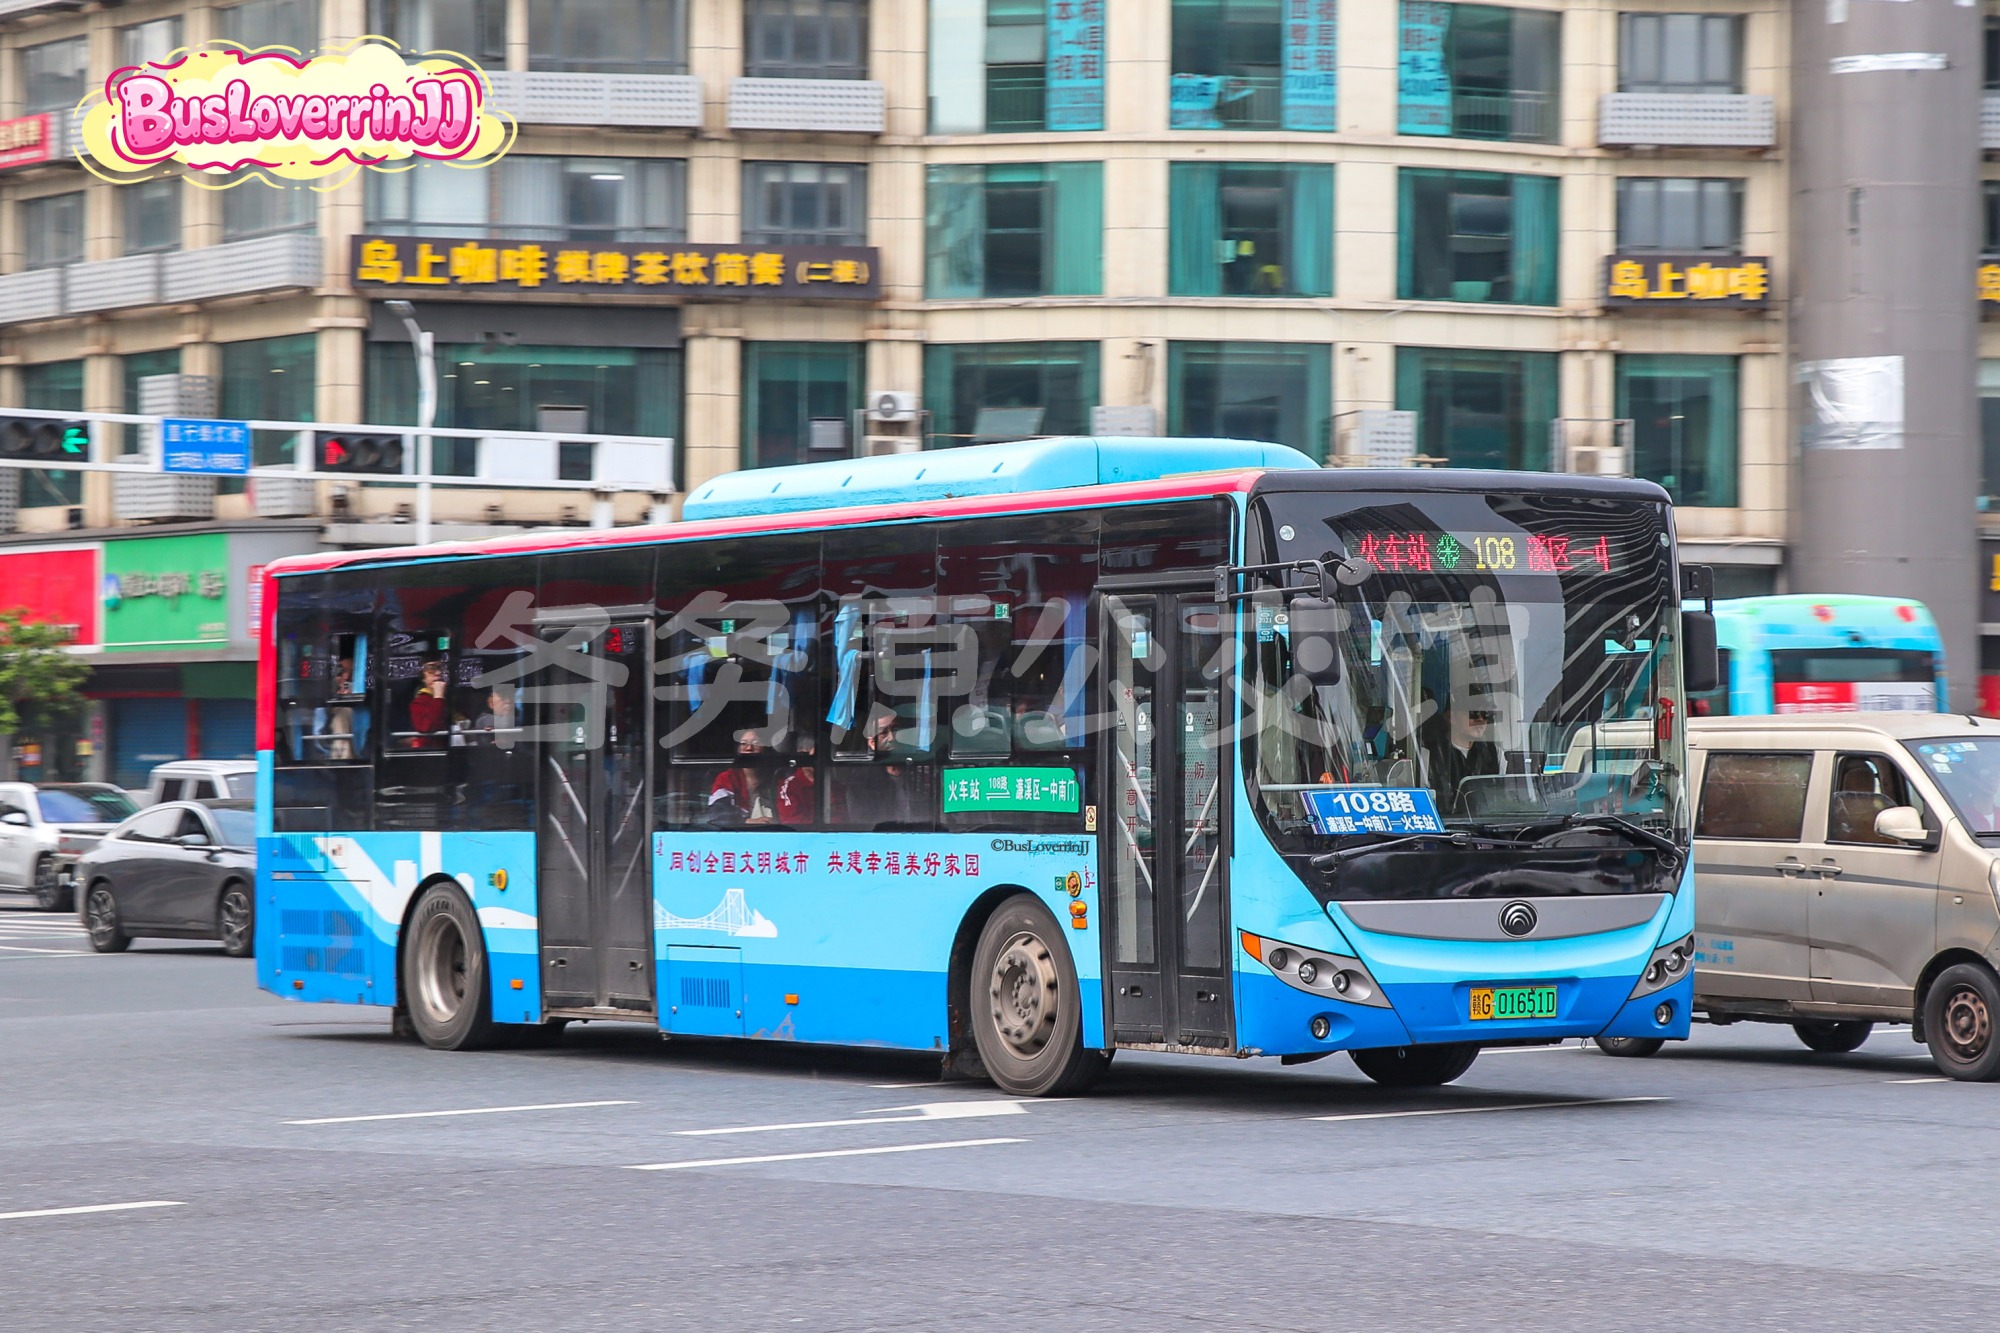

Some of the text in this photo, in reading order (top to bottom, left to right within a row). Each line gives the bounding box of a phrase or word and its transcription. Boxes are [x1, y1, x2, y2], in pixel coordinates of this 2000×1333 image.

[357, 239, 548, 287] 岛上咖啡
[1609, 260, 1768, 300] 岛上咖啡
[1360, 533, 1431, 571] 火车站
[1473, 536, 1516, 569] 108
[948, 778, 1076, 802] 火车站 濂溪区一中南门
[988, 776, 1008, 790] 108路
[1125, 760, 1138, 862] 注意开门
[1332, 792, 1416, 814] 108路
[1400, 814, 1438, 832] 火车站
[669, 850, 981, 877] 同创全国文明城市 共建幸福美好家园
